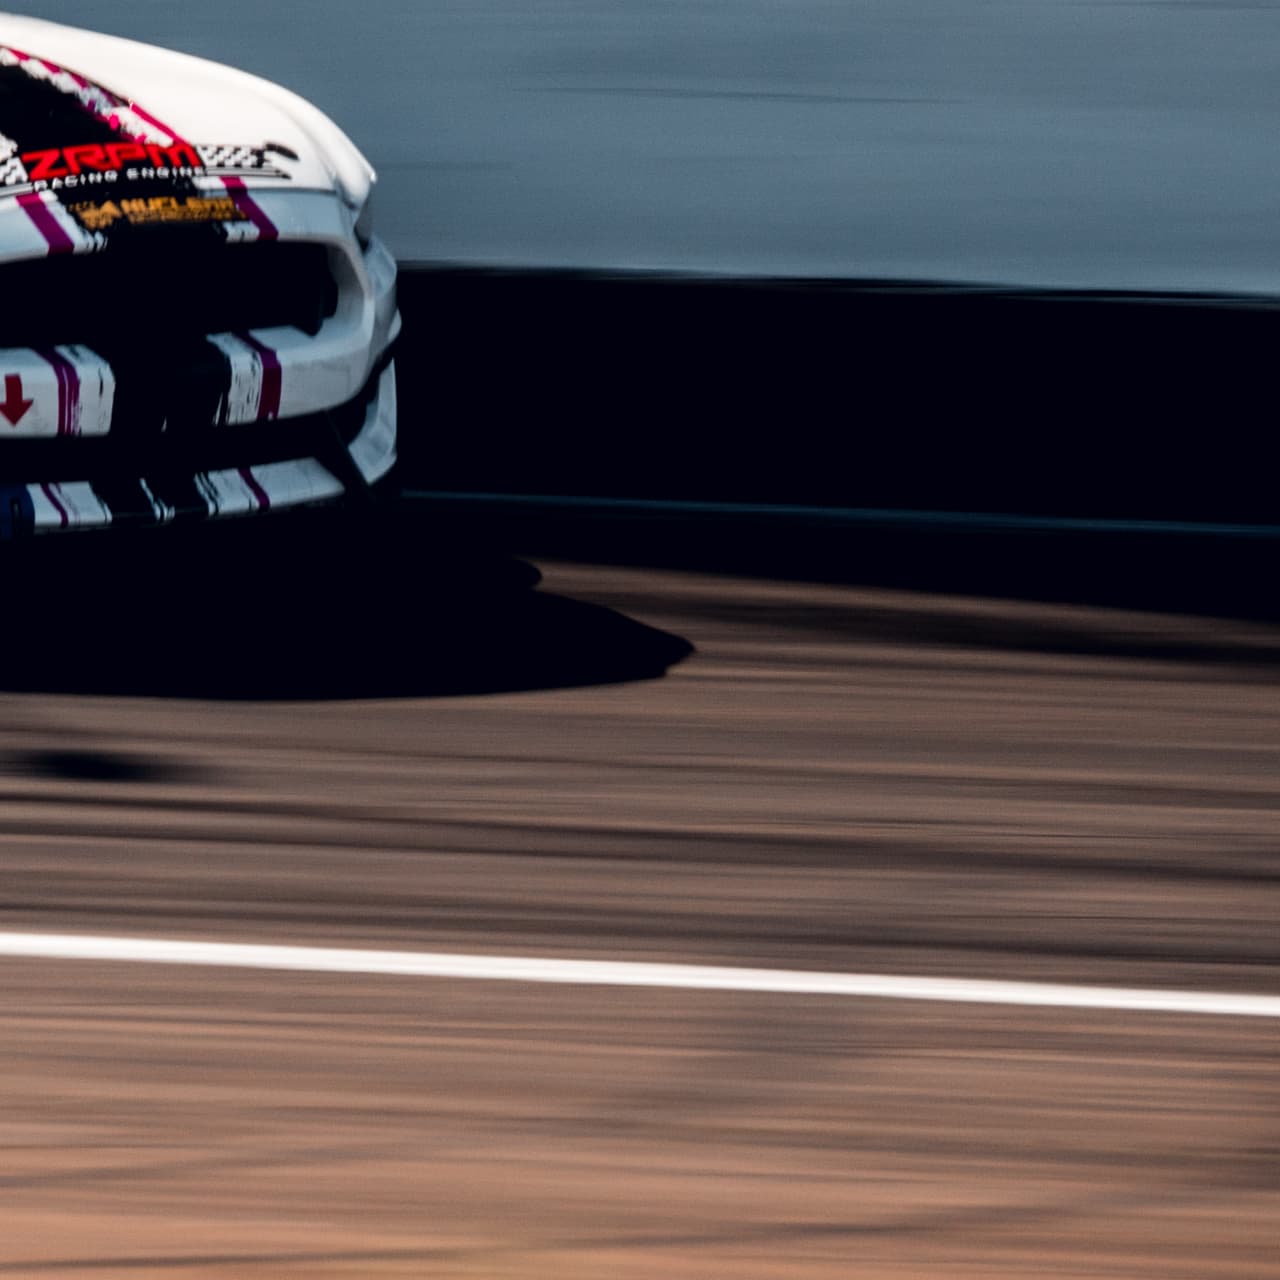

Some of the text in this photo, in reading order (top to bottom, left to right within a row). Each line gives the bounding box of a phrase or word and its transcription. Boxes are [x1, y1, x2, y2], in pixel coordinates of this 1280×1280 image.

[22, 143, 202, 181] ZRPM
[34, 165, 204, 192] RACING ENGINE
